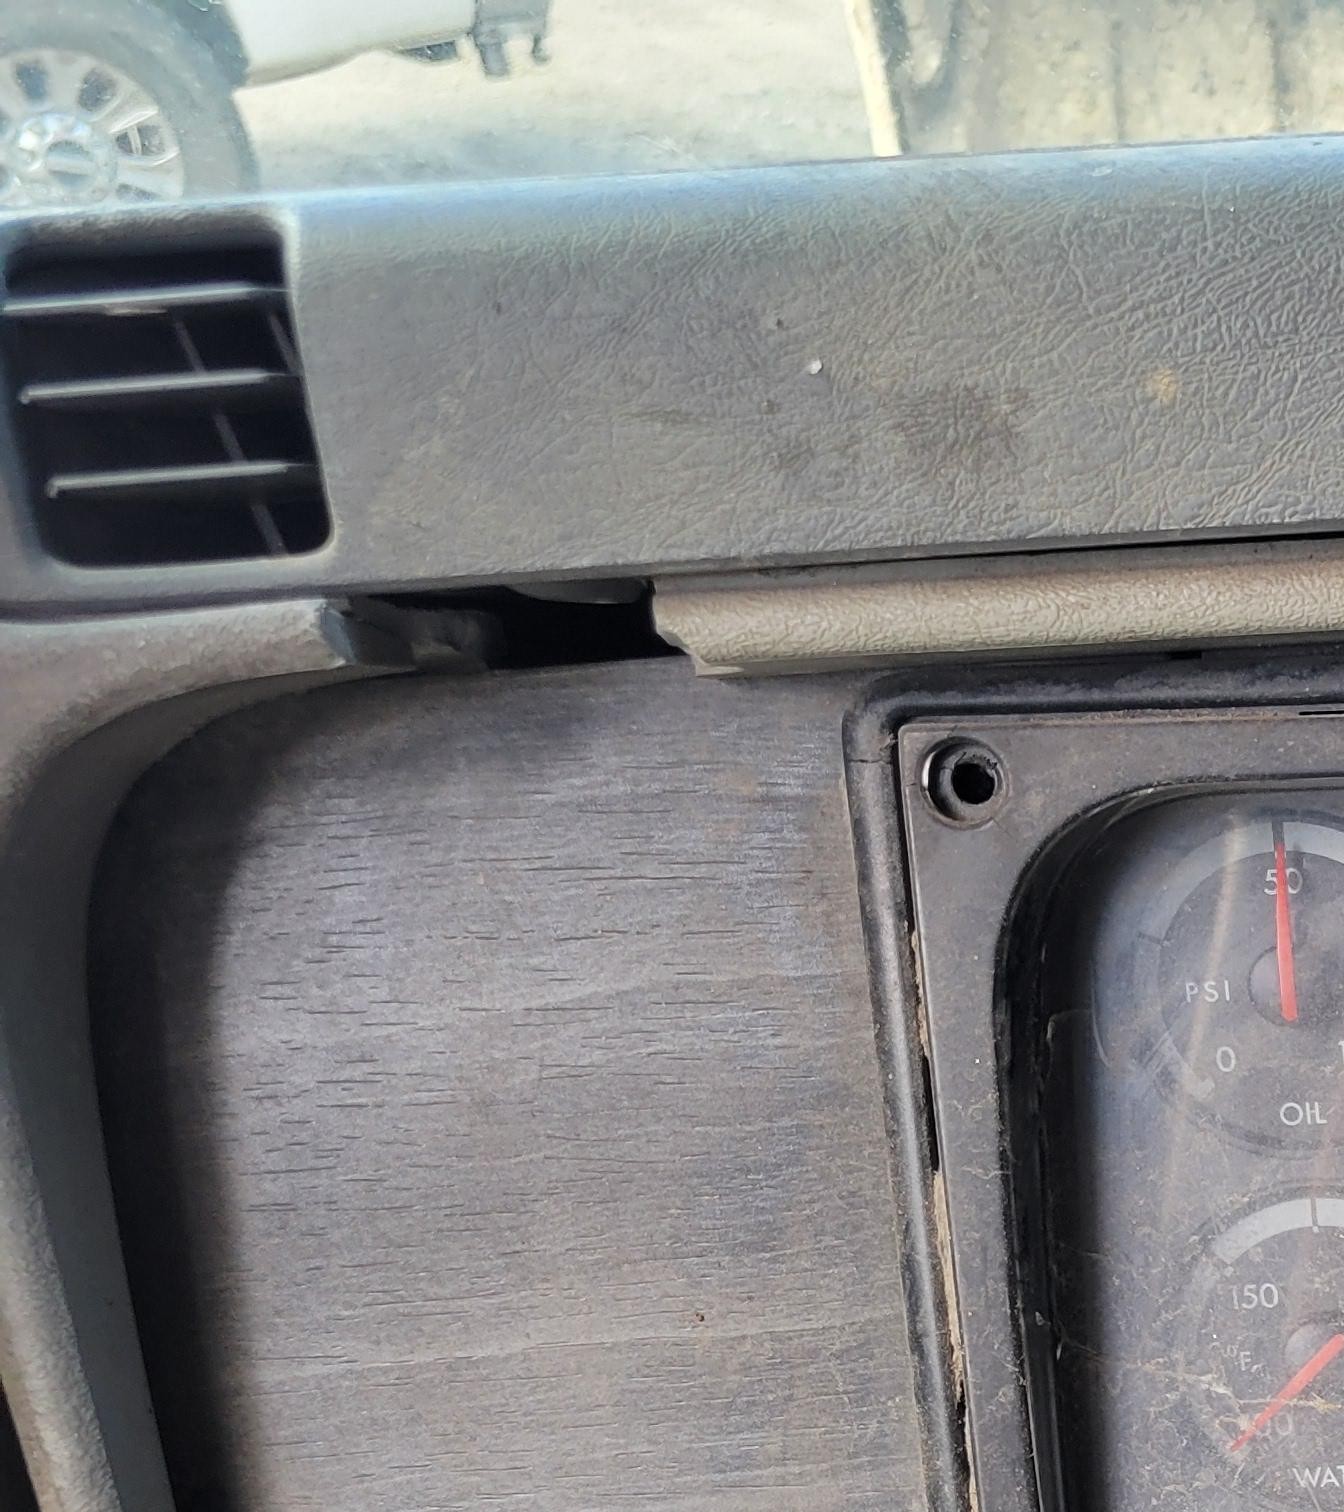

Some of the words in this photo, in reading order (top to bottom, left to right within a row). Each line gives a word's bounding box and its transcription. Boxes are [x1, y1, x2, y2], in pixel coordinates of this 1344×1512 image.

[1186, 980, 1231, 1003] PSI
[1216, 1046, 1236, 1072] 0
[1279, 1102, 1329, 1127] OIL
[1231, 1282, 1279, 1310] 150
